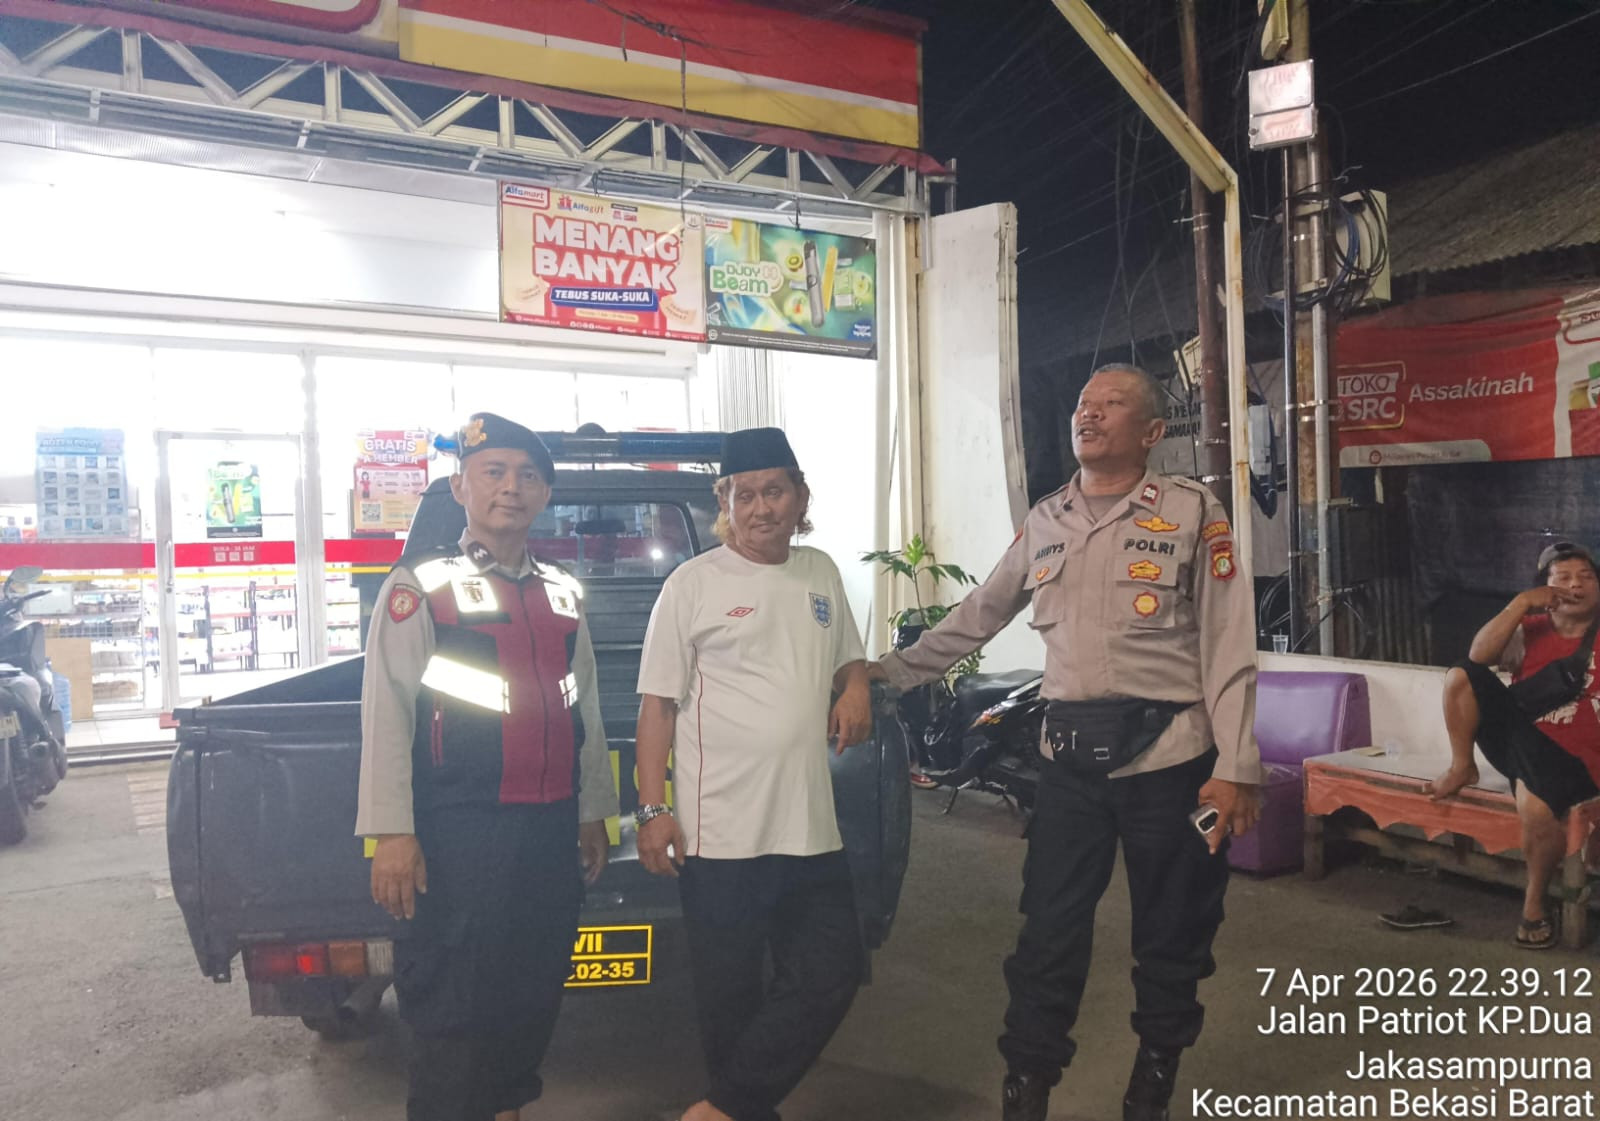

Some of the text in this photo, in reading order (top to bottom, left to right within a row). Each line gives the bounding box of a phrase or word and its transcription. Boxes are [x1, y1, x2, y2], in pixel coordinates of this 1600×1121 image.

[505, 185, 545, 200] Alfamart
[572, 202, 604, 214] Alfagift
[534, 215, 678, 261] MENANG
[534, 247, 675, 291] BANYAK
[712, 269, 769, 293] Beam
[555, 289, 651, 304] TEBUS SUKA-SUKA
[1339, 371, 1534, 403] TOKO Assakinah
[1348, 396, 1397, 421] SRC
[364, 438, 417, 453] GRATIS
[1124, 538, 1176, 556] POLRI
